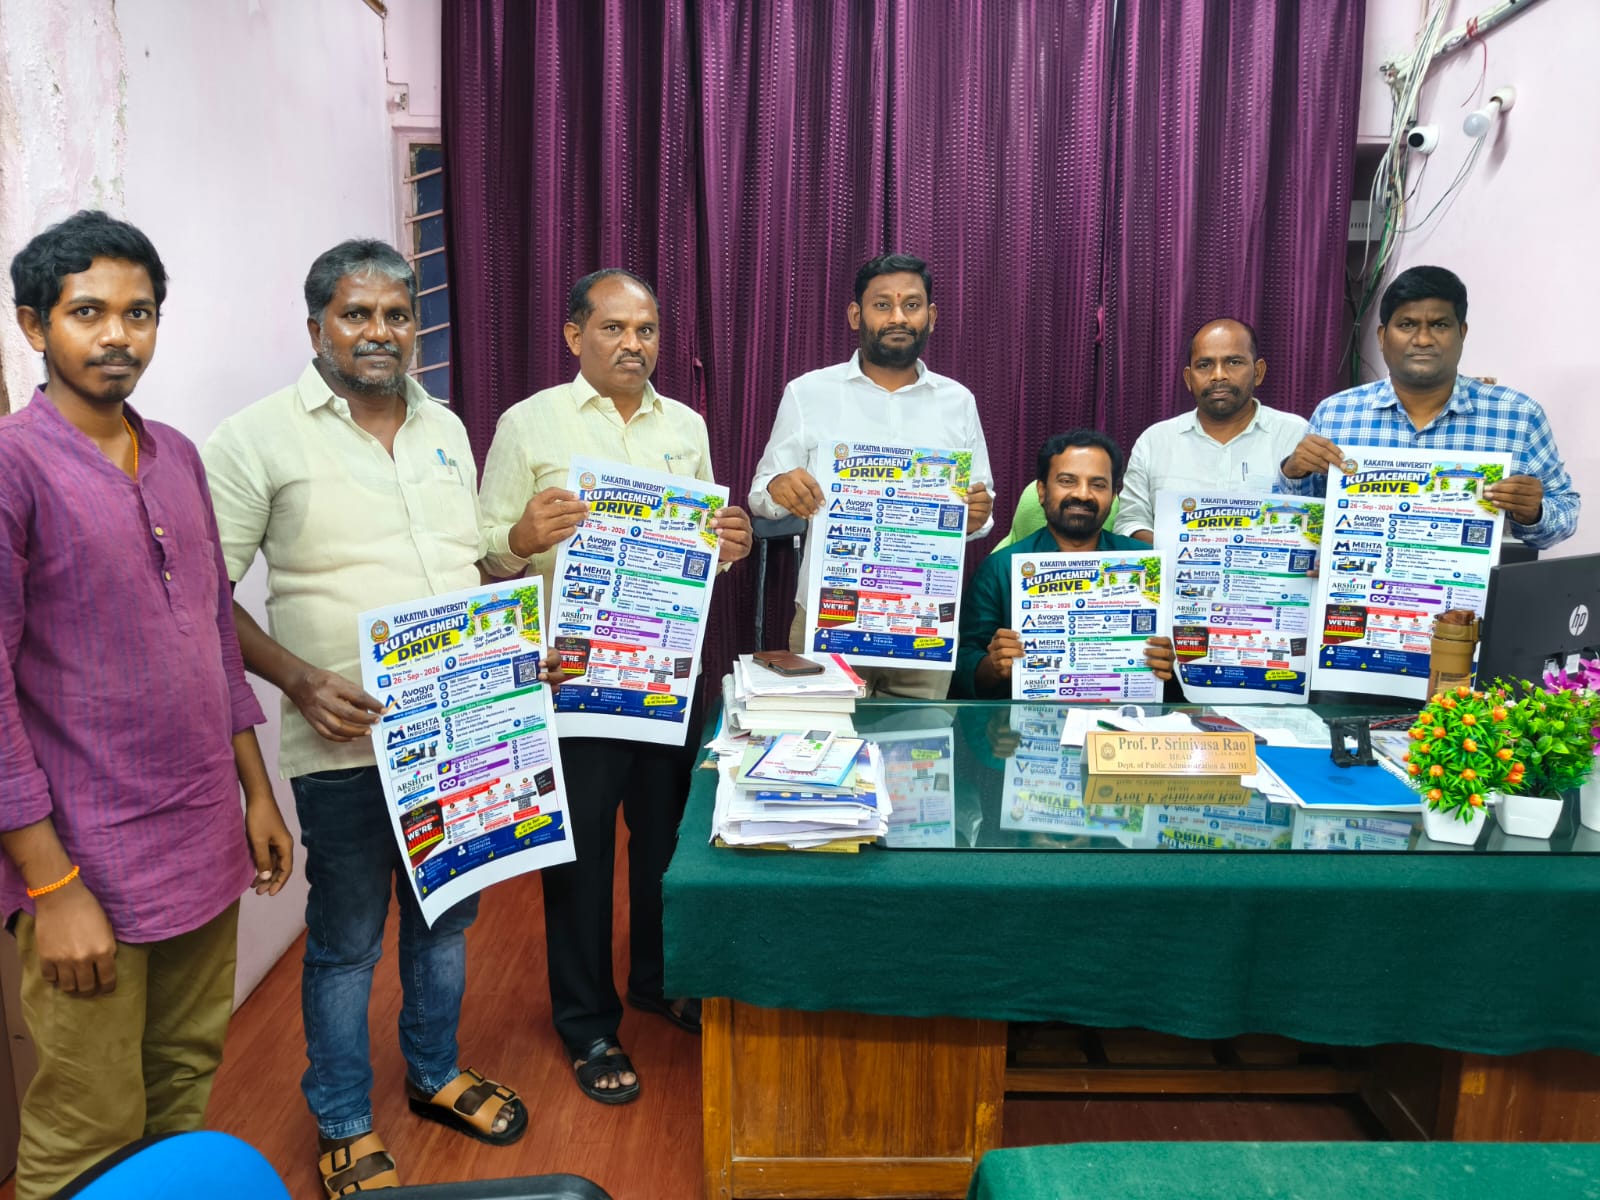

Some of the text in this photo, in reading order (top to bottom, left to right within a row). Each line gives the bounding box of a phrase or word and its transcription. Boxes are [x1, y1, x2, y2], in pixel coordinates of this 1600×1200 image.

[854, 444, 913, 455] KAKATIYA UNIVERSITY
[839, 458, 908, 469] KU PLACEMENT
[1363, 459, 1432, 469] KAKATIYA UNIVERSITY
[850, 468, 894, 478] DRIVE
[1346, 472, 1427, 485] KU PLACEMENT
[602, 474, 665, 493] KAKATIYA UNIVERSITY
[1359, 483, 1409, 493] DRIVE
[584, 490, 660, 506] KU PLACEMENT
[846, 499, 873, 508] Avogya
[596, 502, 643, 516] DRIVE
[1186, 509, 1258, 520] KU PLACEMENT
[1198, 518, 1242, 527] DRIVE
[1354, 514, 1384, 523] Avogya
[596, 524, 608, 532] Sep
[587, 543, 612, 552] Solutions
[588, 535, 616, 547] Avogya
[584, 565, 611, 576] MEHTA
[1027, 570, 1097, 587] KU PLACEMENT
[1039, 581, 1083, 593] DRIVE
[394, 601, 468, 624] KAKATIYA UNIVERSITY
[561, 611, 592, 621] ARSHITH
[1571, 606, 1588, 636] hp
[380, 615, 465, 656] KU PLACEMENT
[398, 632, 451, 661] DRIVE
[407, 673, 419, 681] Sep
[424, 666, 440, 676] 2026
[402, 683, 434, 698] Avogya
[403, 693, 432, 706] Solutions
[407, 716, 439, 732] MEHTA
[408, 724, 440, 737] INDUSTRIES
[1119, 737, 1246, 750] Prof. P. Srinivasa Rao
[397, 773, 433, 792] ARSHITH
[407, 823, 433, 840] WE'RE
